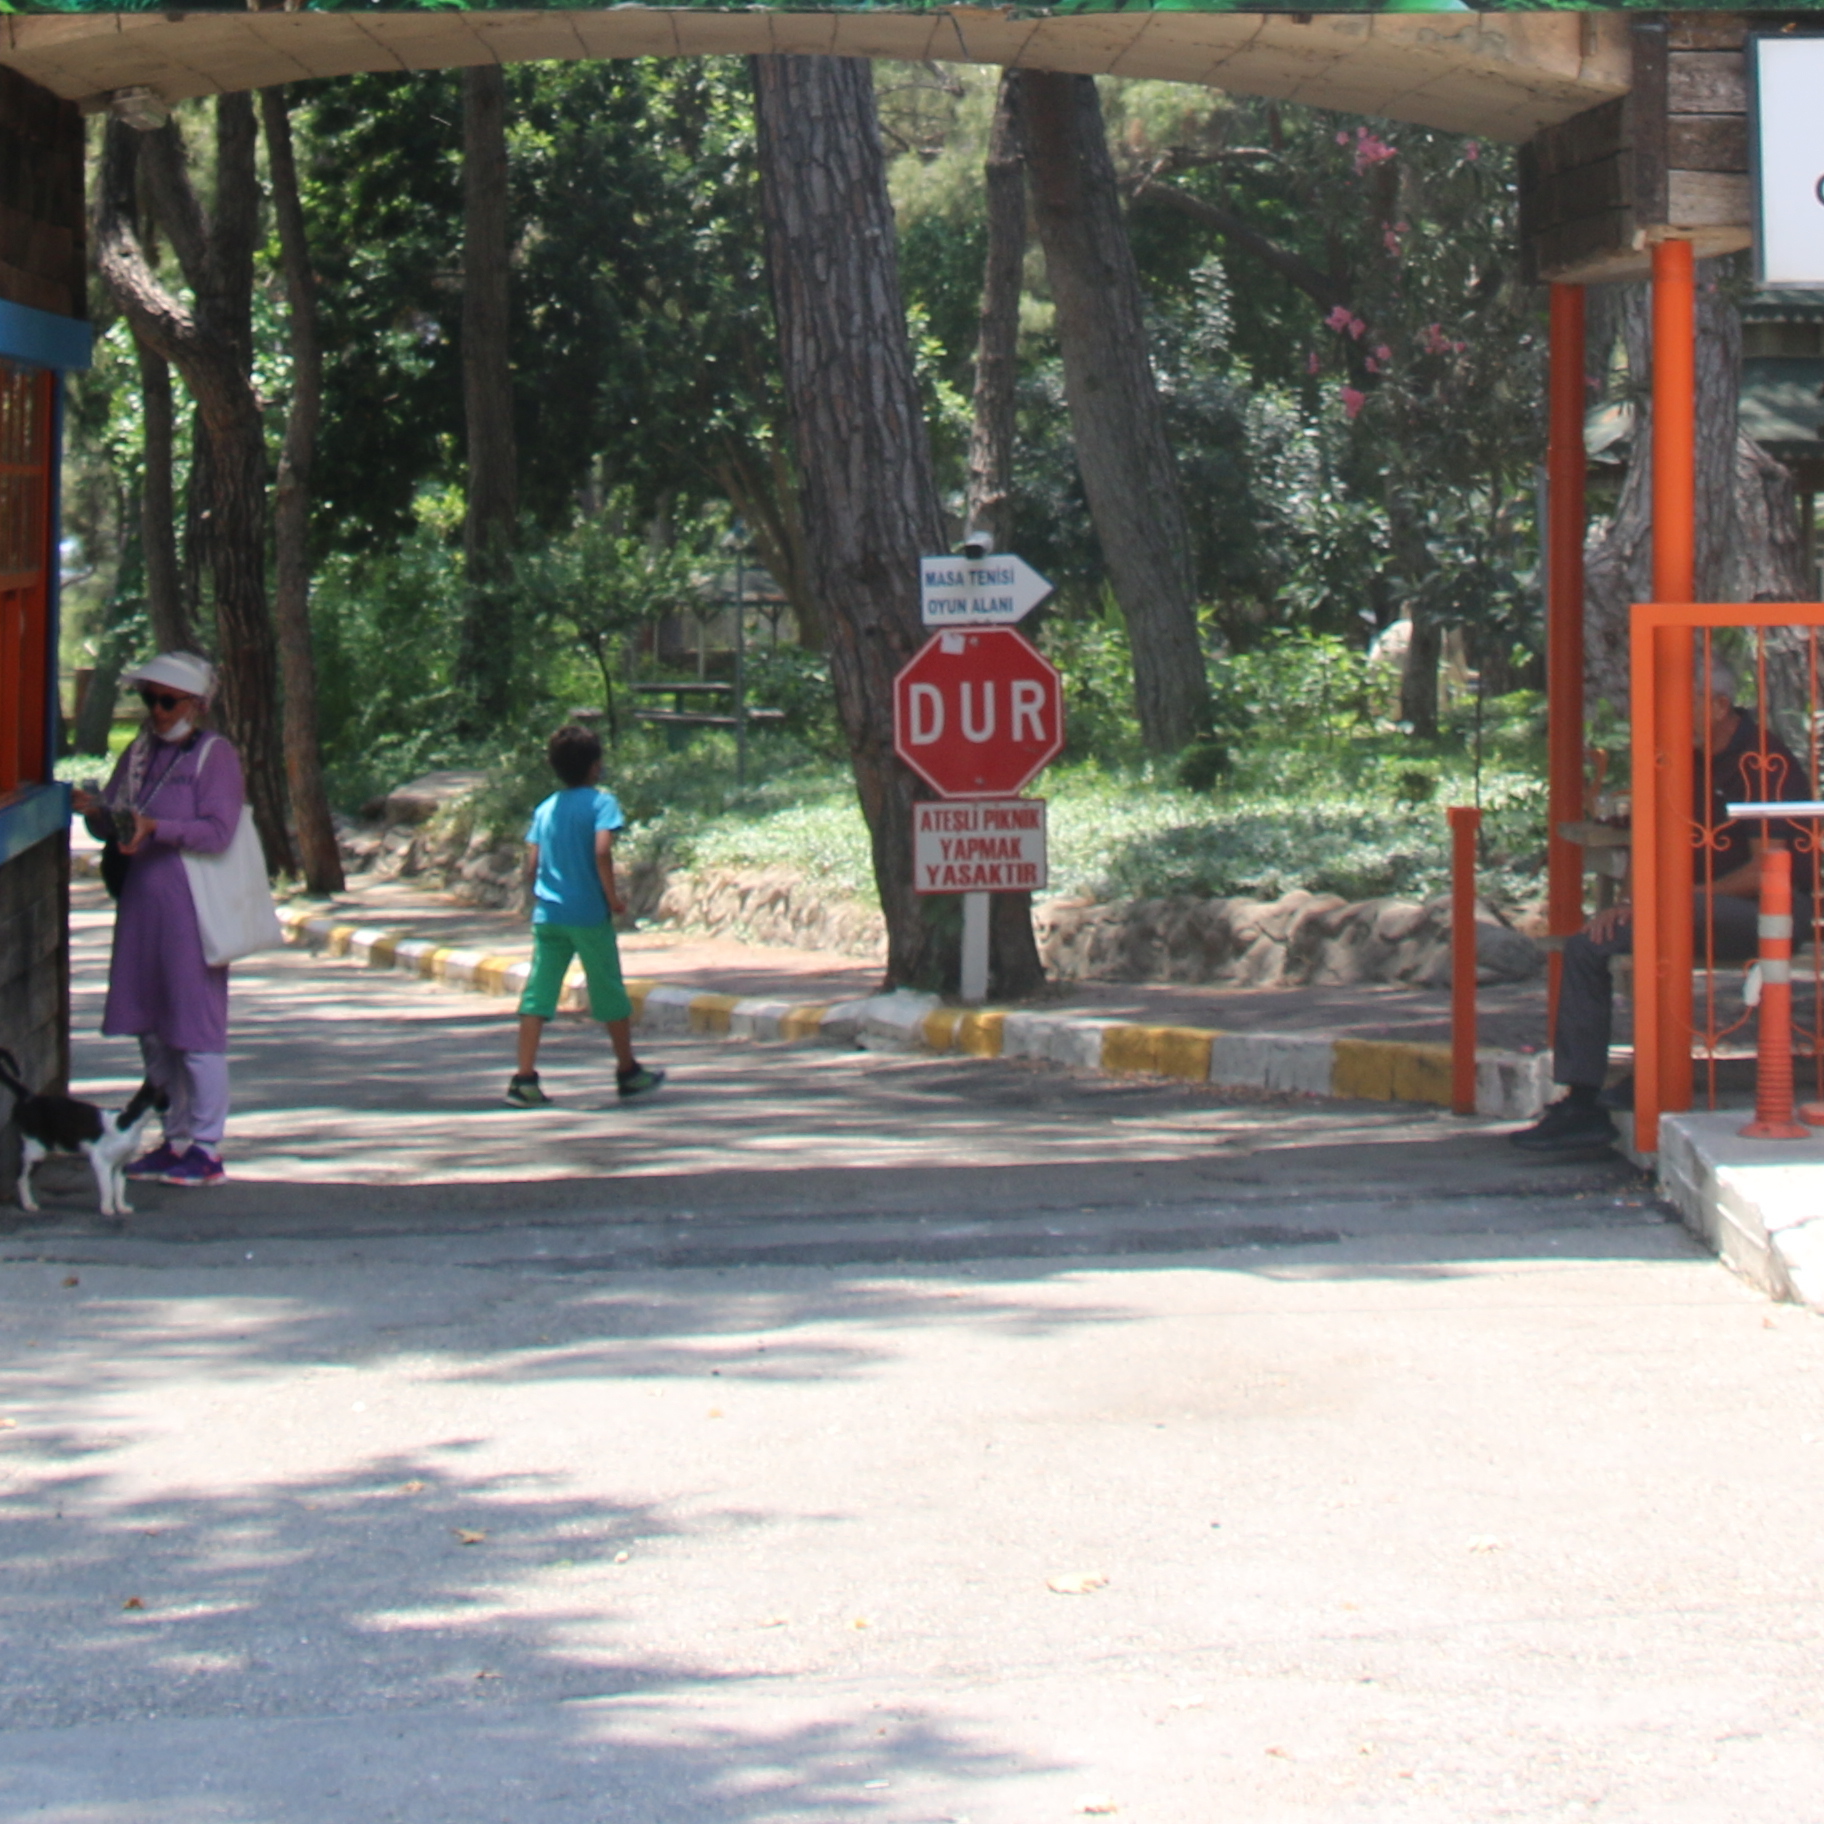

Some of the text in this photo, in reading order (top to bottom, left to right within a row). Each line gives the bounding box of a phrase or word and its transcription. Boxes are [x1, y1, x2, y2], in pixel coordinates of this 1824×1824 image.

[926, 566, 1015, 587] MASA TENİSİ
[928, 597, 1014, 615] OYUN ALANI
[909, 680, 1047, 745] DUR
[940, 837, 1022, 860] YAPMAK
[927, 863, 1038, 886] YASAKTIR
